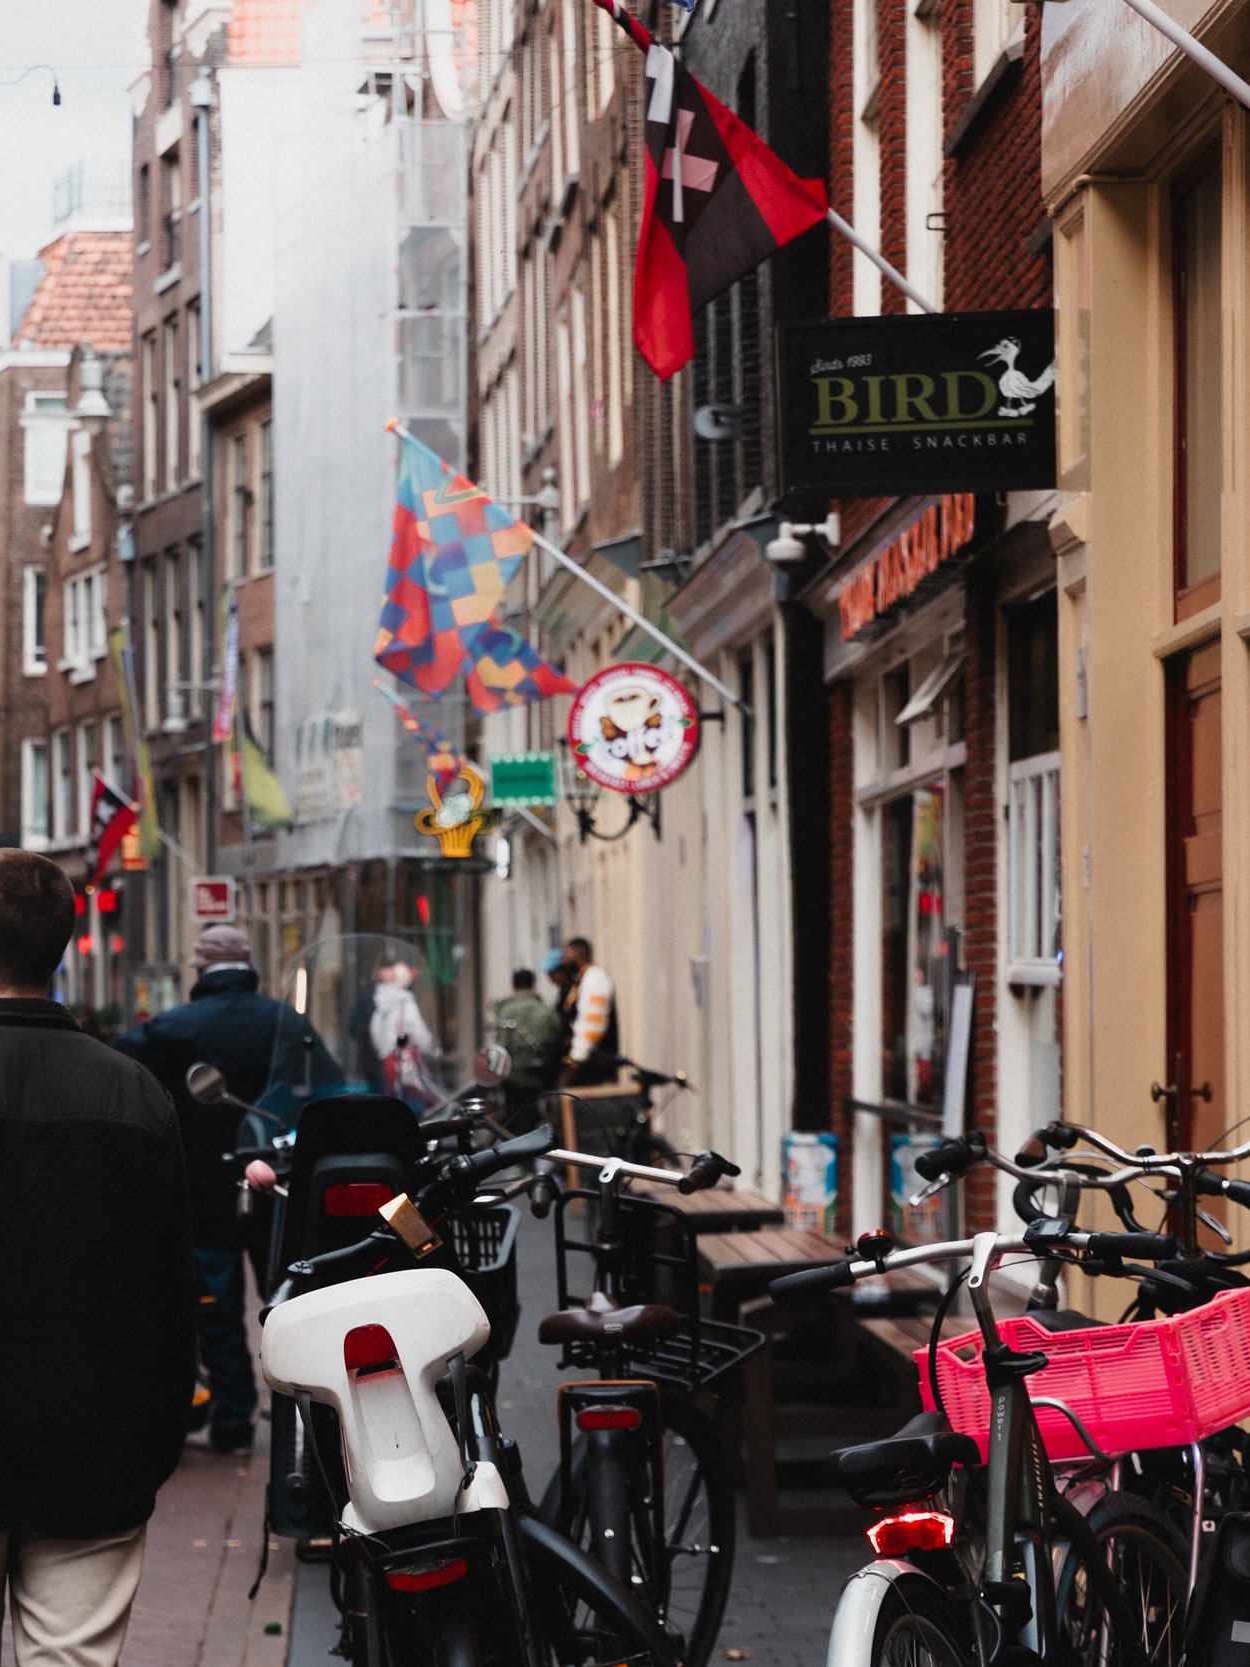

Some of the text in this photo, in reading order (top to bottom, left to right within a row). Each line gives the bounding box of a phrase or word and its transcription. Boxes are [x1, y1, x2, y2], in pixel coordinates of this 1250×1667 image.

[812, 371, 998, 426] BIRD
[813, 432, 1028, 453] THAISE SNACKBAR
[996, 1396, 1005, 1430] power
